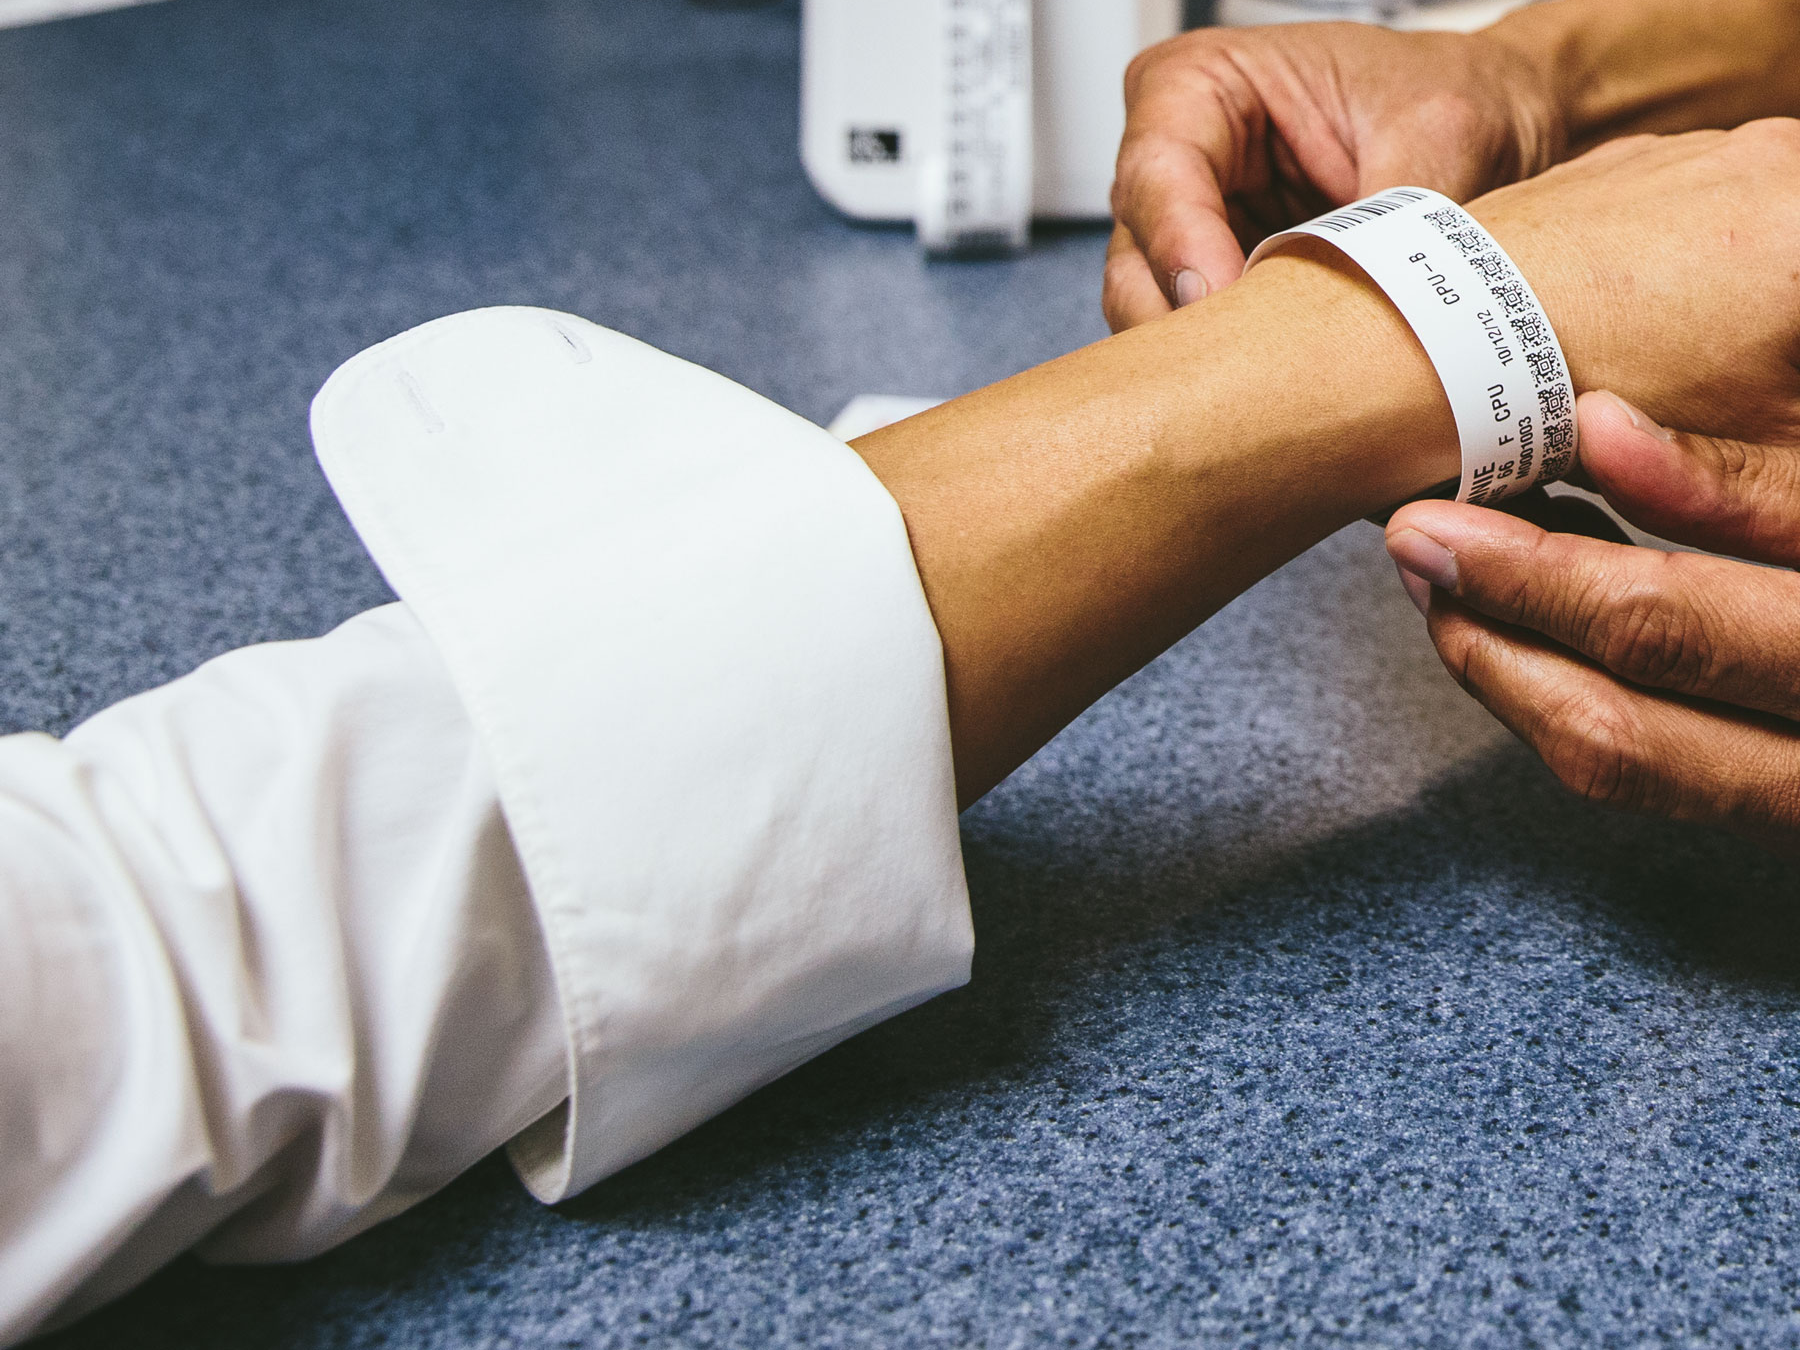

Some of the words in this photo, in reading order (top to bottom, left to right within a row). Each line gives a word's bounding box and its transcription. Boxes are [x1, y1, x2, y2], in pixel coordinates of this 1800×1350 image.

[1476, 308, 1515, 367] 10/12/12
[1487, 383, 1512, 423] CPU
[1498, 434, 1515, 446] F
[1496, 460, 1515, 479] 66
